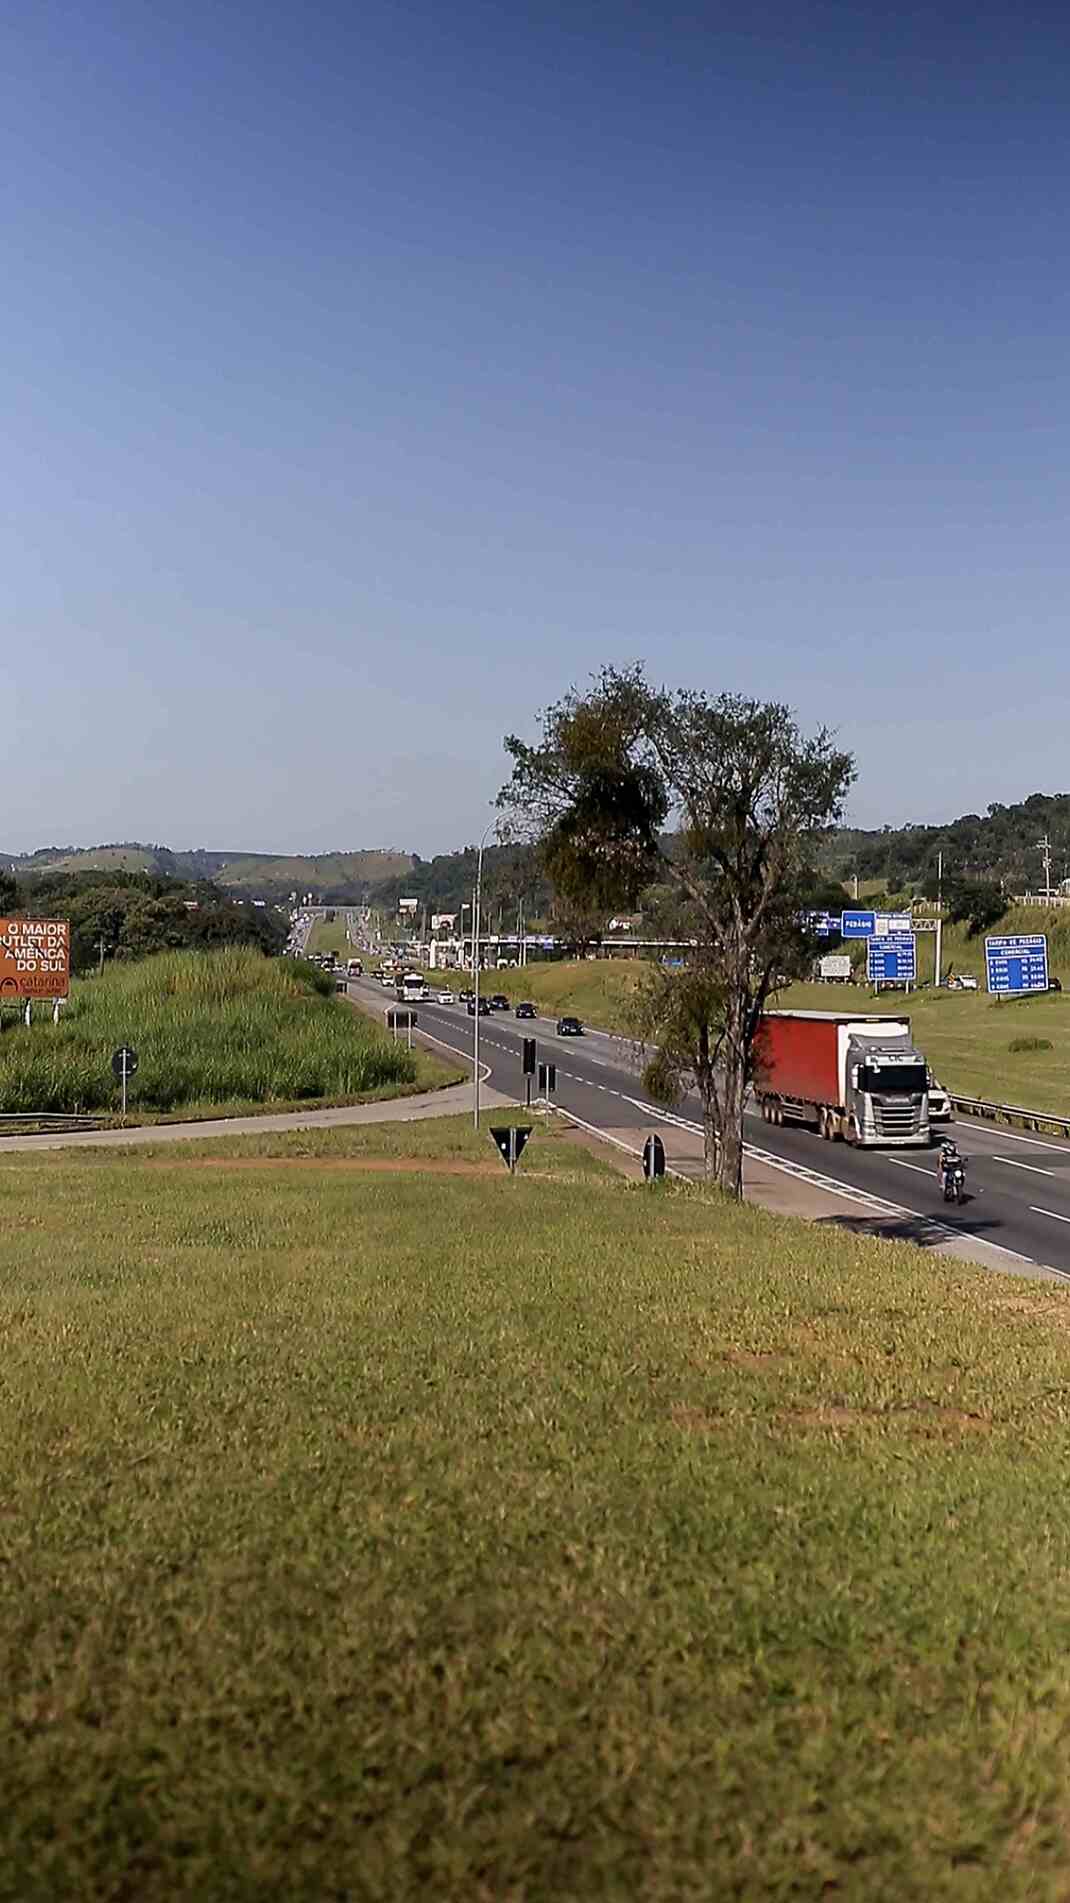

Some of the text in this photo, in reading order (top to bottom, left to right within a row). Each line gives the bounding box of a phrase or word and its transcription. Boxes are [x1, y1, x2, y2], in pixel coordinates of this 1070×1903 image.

[8, 923, 66, 935] O MAIOR
[0, 935, 65, 947] UTLET DA
[17, 960, 66, 971] DO SUL
